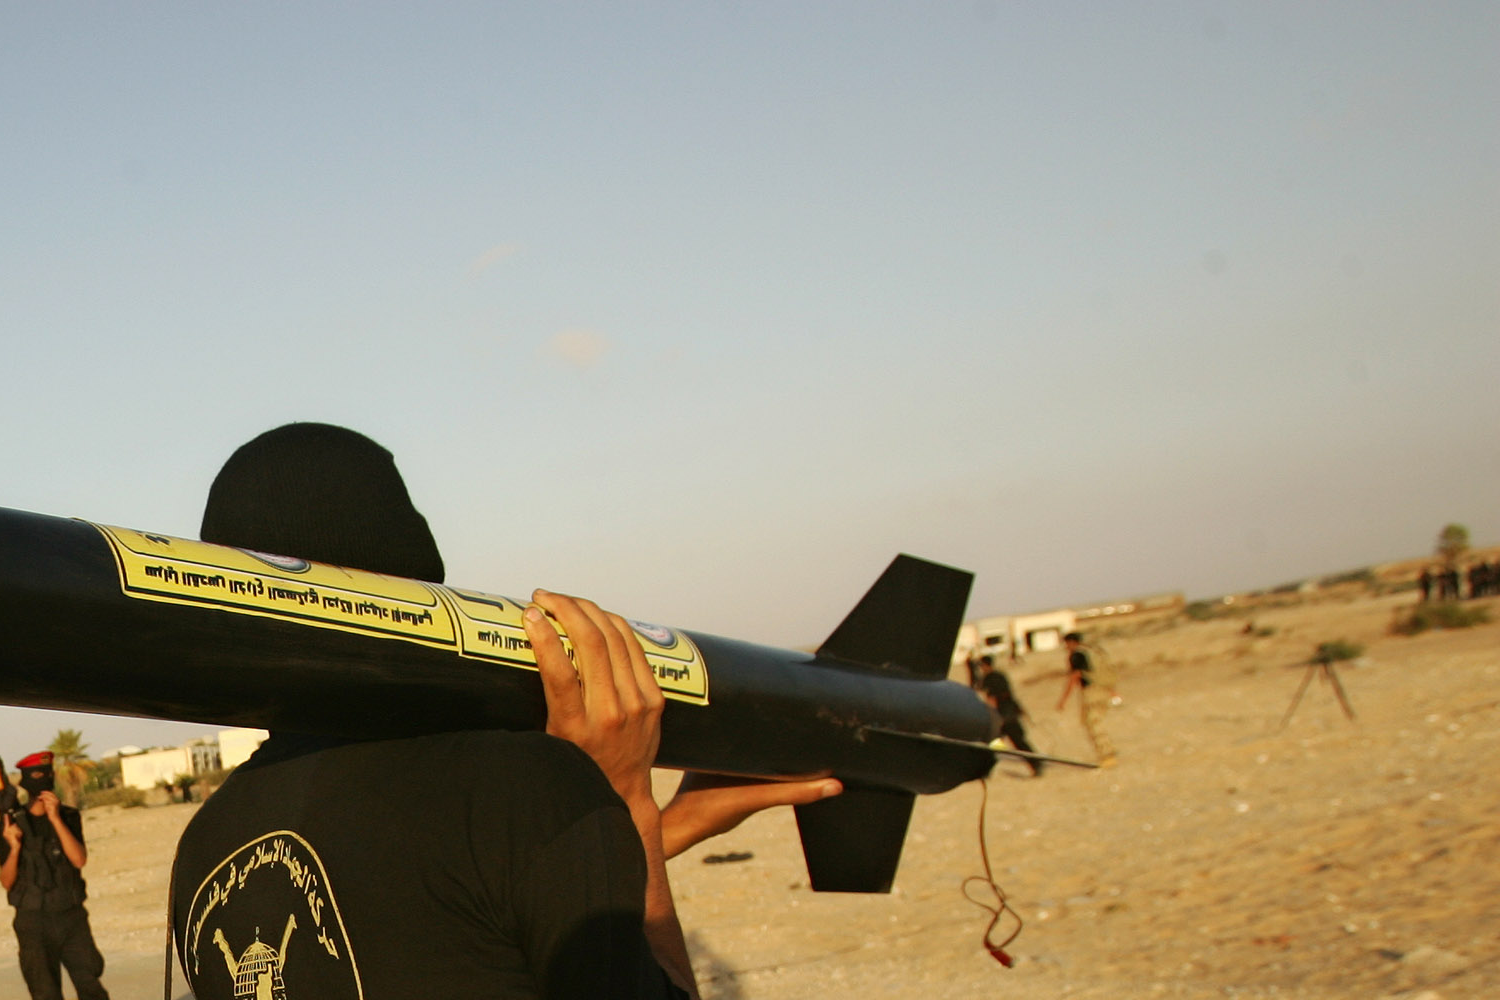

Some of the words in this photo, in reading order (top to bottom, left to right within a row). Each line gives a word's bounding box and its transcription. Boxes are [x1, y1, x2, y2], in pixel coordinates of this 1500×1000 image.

[145, 565, 179, 584] سرايا
[182, 571, 226, 588] القدس
[229, 578, 264, 597] الذراع
[267, 586, 319, 606] العسكري
[322, 596, 353, 614] لحركة
[355, 600, 389, 619] الجهاد
[478, 631, 502, 648] سرايا
[220, 862, 236, 906] في
[308, 874, 339, 960] حركة
